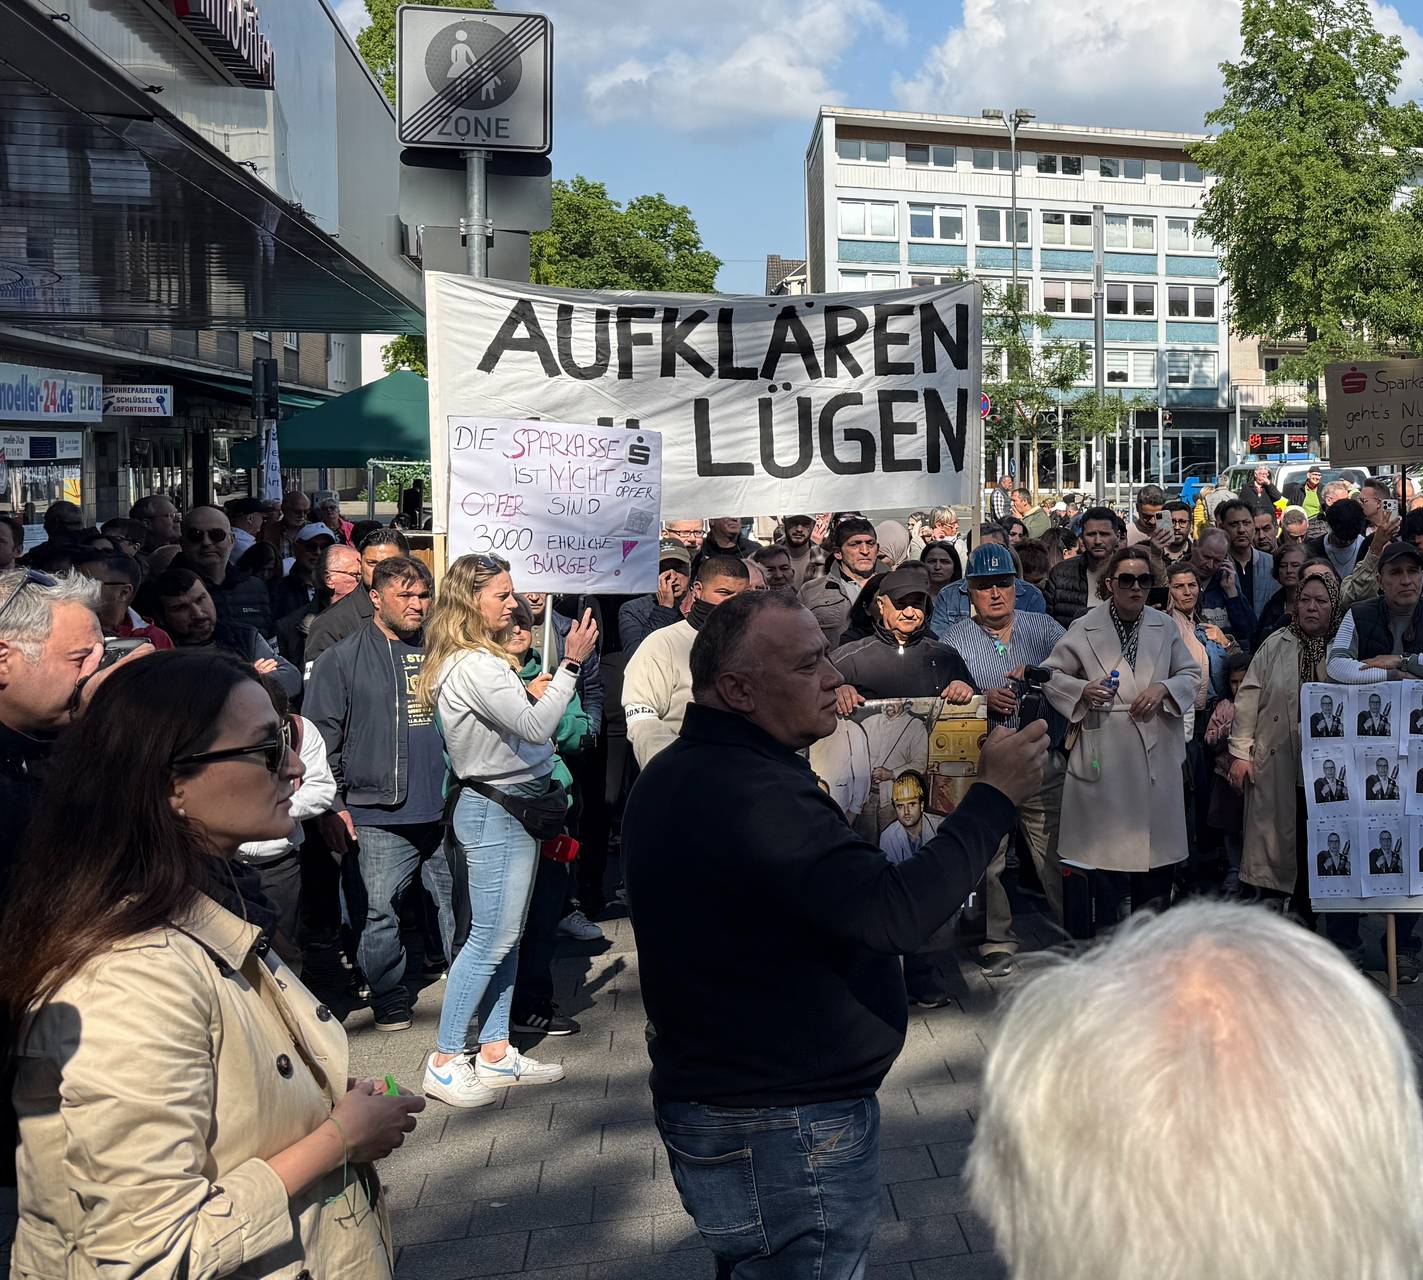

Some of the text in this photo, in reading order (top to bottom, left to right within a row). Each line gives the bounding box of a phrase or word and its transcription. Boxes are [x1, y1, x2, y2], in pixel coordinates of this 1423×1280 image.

[437, 115, 510, 139] ZONE
[476, 299, 970, 380] AUFKLÄREN
[113, 405, 160, 413] SOFORTDIENST
[116, 396, 153, 404] SCHLÜSSEL
[1346, 403, 1390, 430] geht's
[694, 382, 967, 479] LÜGEN
[1344, 426, 1385, 451] um's
[503, 428, 625, 460] SPARKASSE
[619, 471, 643, 483] DAS
[461, 491, 531, 518] OPFER
[616, 486, 655, 500] OPFER
[470, 524, 534, 553] 3000
[526, 552, 605, 575] BÜRGER
